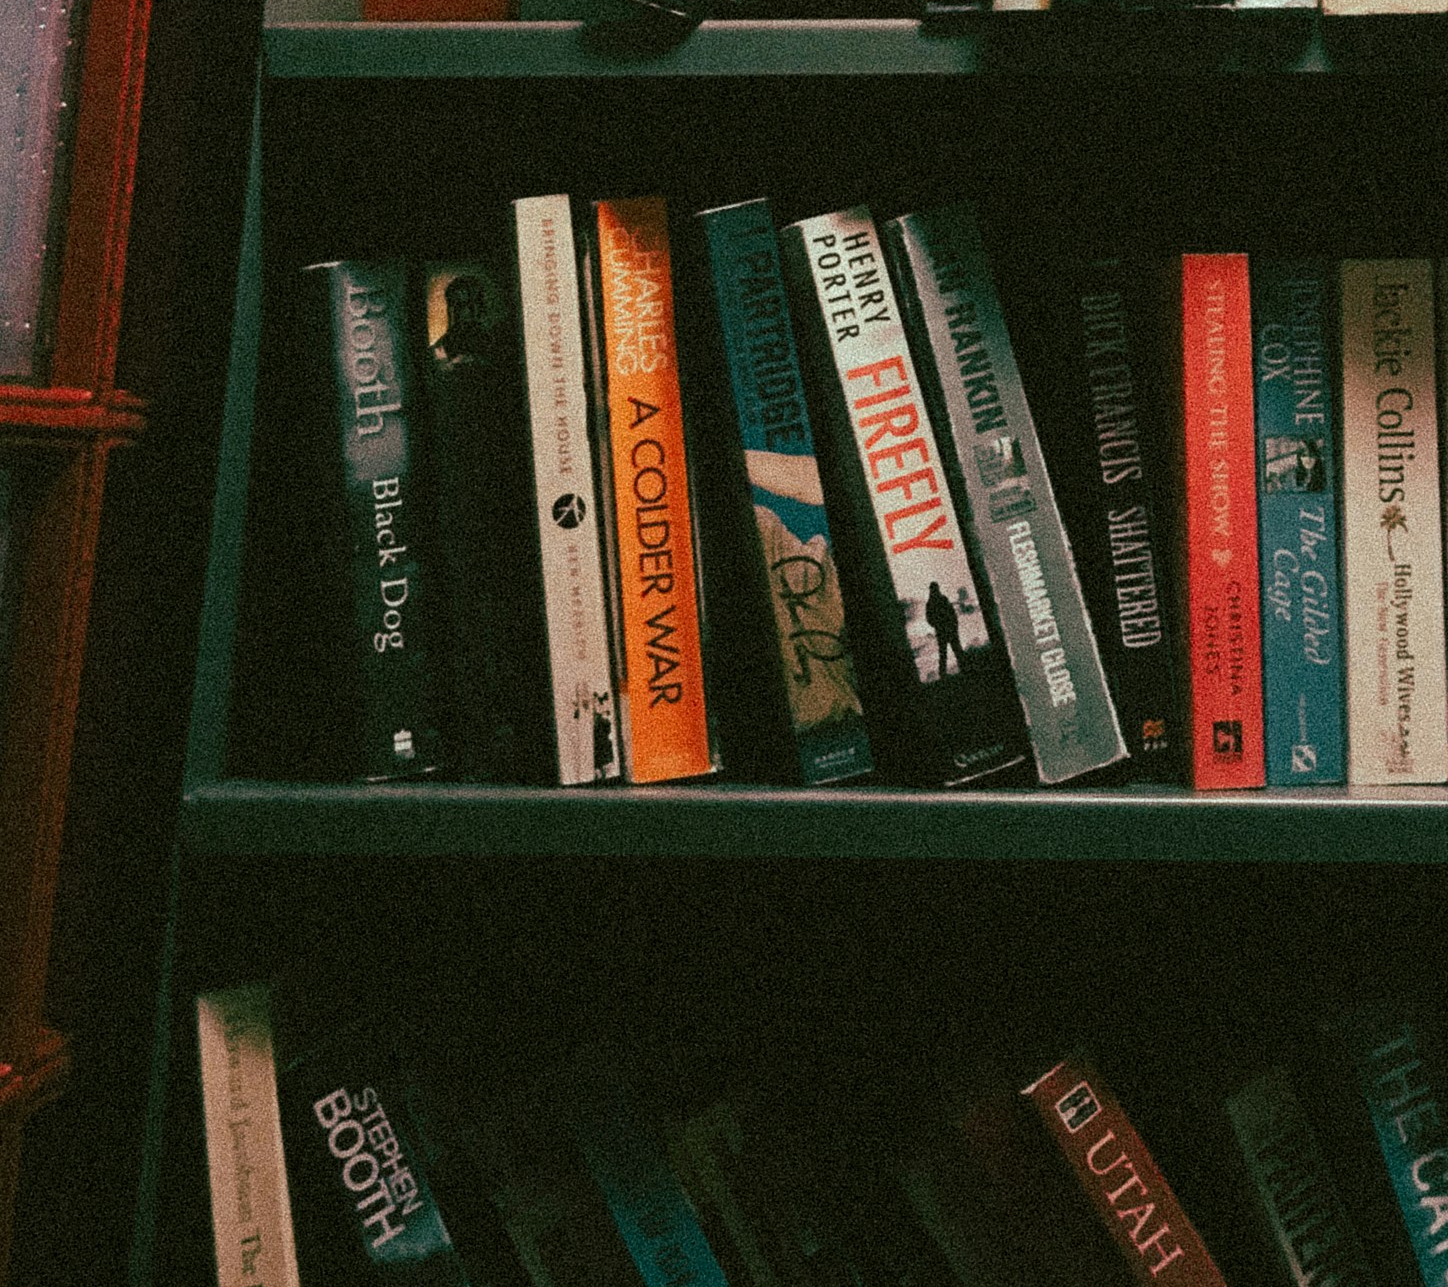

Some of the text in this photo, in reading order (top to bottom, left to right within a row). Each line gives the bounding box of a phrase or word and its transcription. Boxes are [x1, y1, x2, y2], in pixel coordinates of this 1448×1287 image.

[539, 217, 574, 475] BRINGING DOWN THE HOUSE
[811, 233, 861, 345] PORTER
[841, 231, 892, 326] HENRY
[1261, 322, 1295, 382] COX
[348, 283, 404, 438] Booth
[941, 302, 1011, 435] RANKIN
[1092, 365, 1143, 485] FRANCIS
[1203, 276, 1231, 536] STEALING THE SHOW
[1374, 273, 1417, 504] Jackie Collins
[846, 355, 956, 559] FIREFLY
[371, 476, 411, 654] Black Dog
[627, 396, 684, 709] A COLDER WAR
[1009, 519, 1077, 708] FLESHMARKET CLOSE
[1104, 504, 1163, 650] SHATTERED
[1266, 548, 1298, 622] Cage
[1299, 504, 1331, 665] The Gilded
[1227, 579, 1246, 697] CHRISTINA
[1388, 561, 1417, 721] Hollywood Wives
[352, 1087, 425, 1216] STEPHEN
[1369, 1024, 1440, 1142] THE
[312, 1087, 407, 1248] BOOTH
[1085, 1129, 1184, 1277] UTAH
[240, 1233, 262, 1276] The
